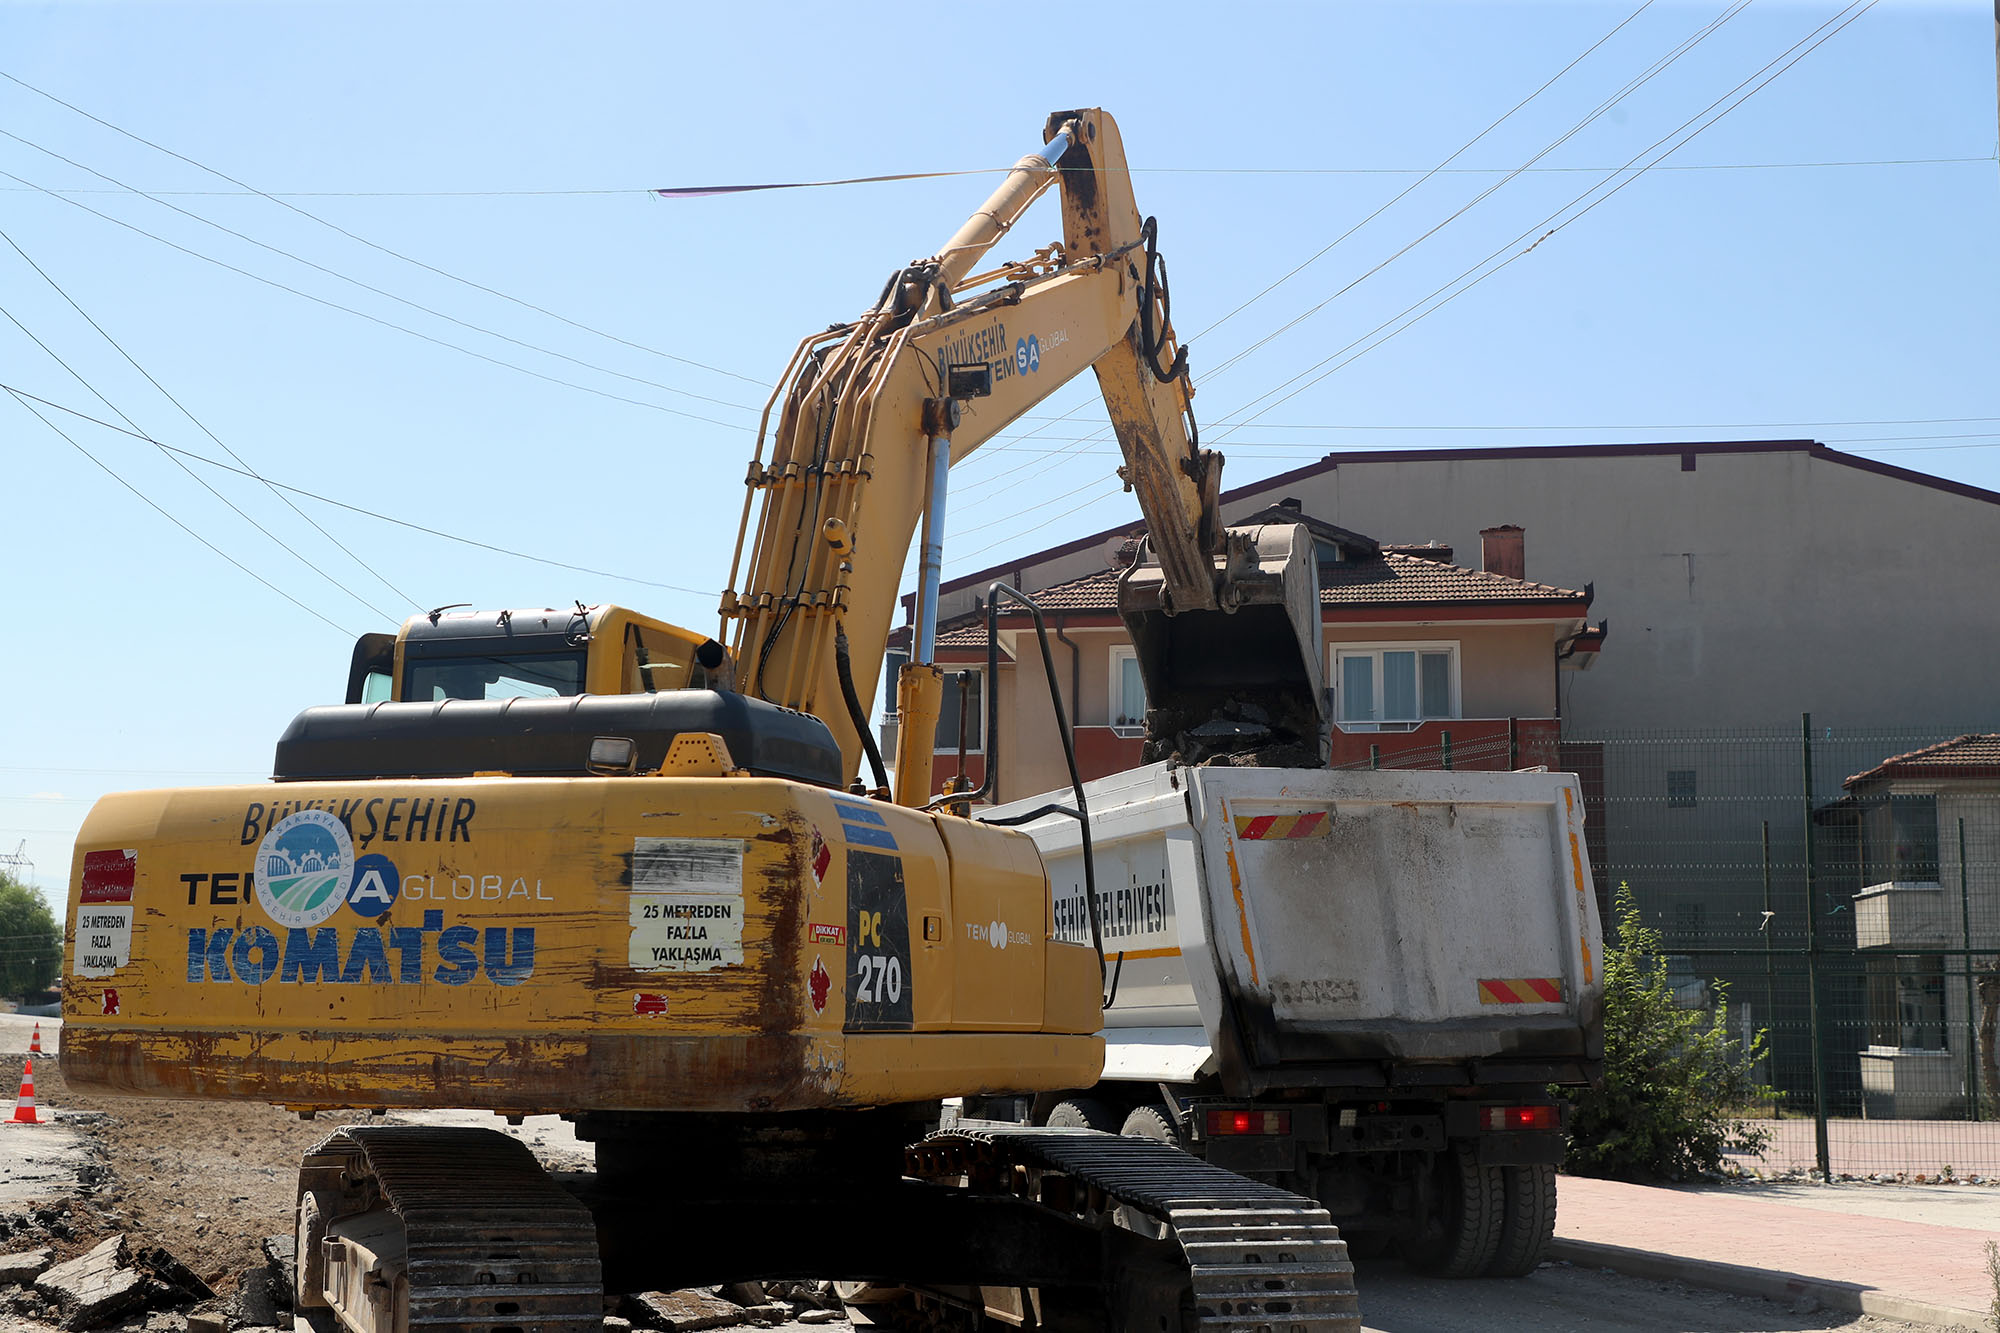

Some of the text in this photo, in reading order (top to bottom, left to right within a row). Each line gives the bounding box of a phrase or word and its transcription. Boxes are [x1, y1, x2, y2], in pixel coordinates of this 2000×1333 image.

[1040, 328, 1070, 354] GLOBAL
[276, 813, 335, 833] SAKARYA
[401, 874, 554, 901] GLOBAL
[643, 904, 732, 919] 25 METREDEN
[82, 915, 126, 929] 25 METREDEN
[859, 911, 882, 948] PC
[91, 935, 112, 949] FAZLA
[666, 926, 708, 940] FAZLA
[1008, 930, 1033, 946] GLOBAL
[187, 909, 536, 987] KOMATSU
[651, 947, 722, 965] YAKLAŞMA
[83, 955, 118, 972] YAKLAŞMA
[856, 954, 902, 1004] 270
